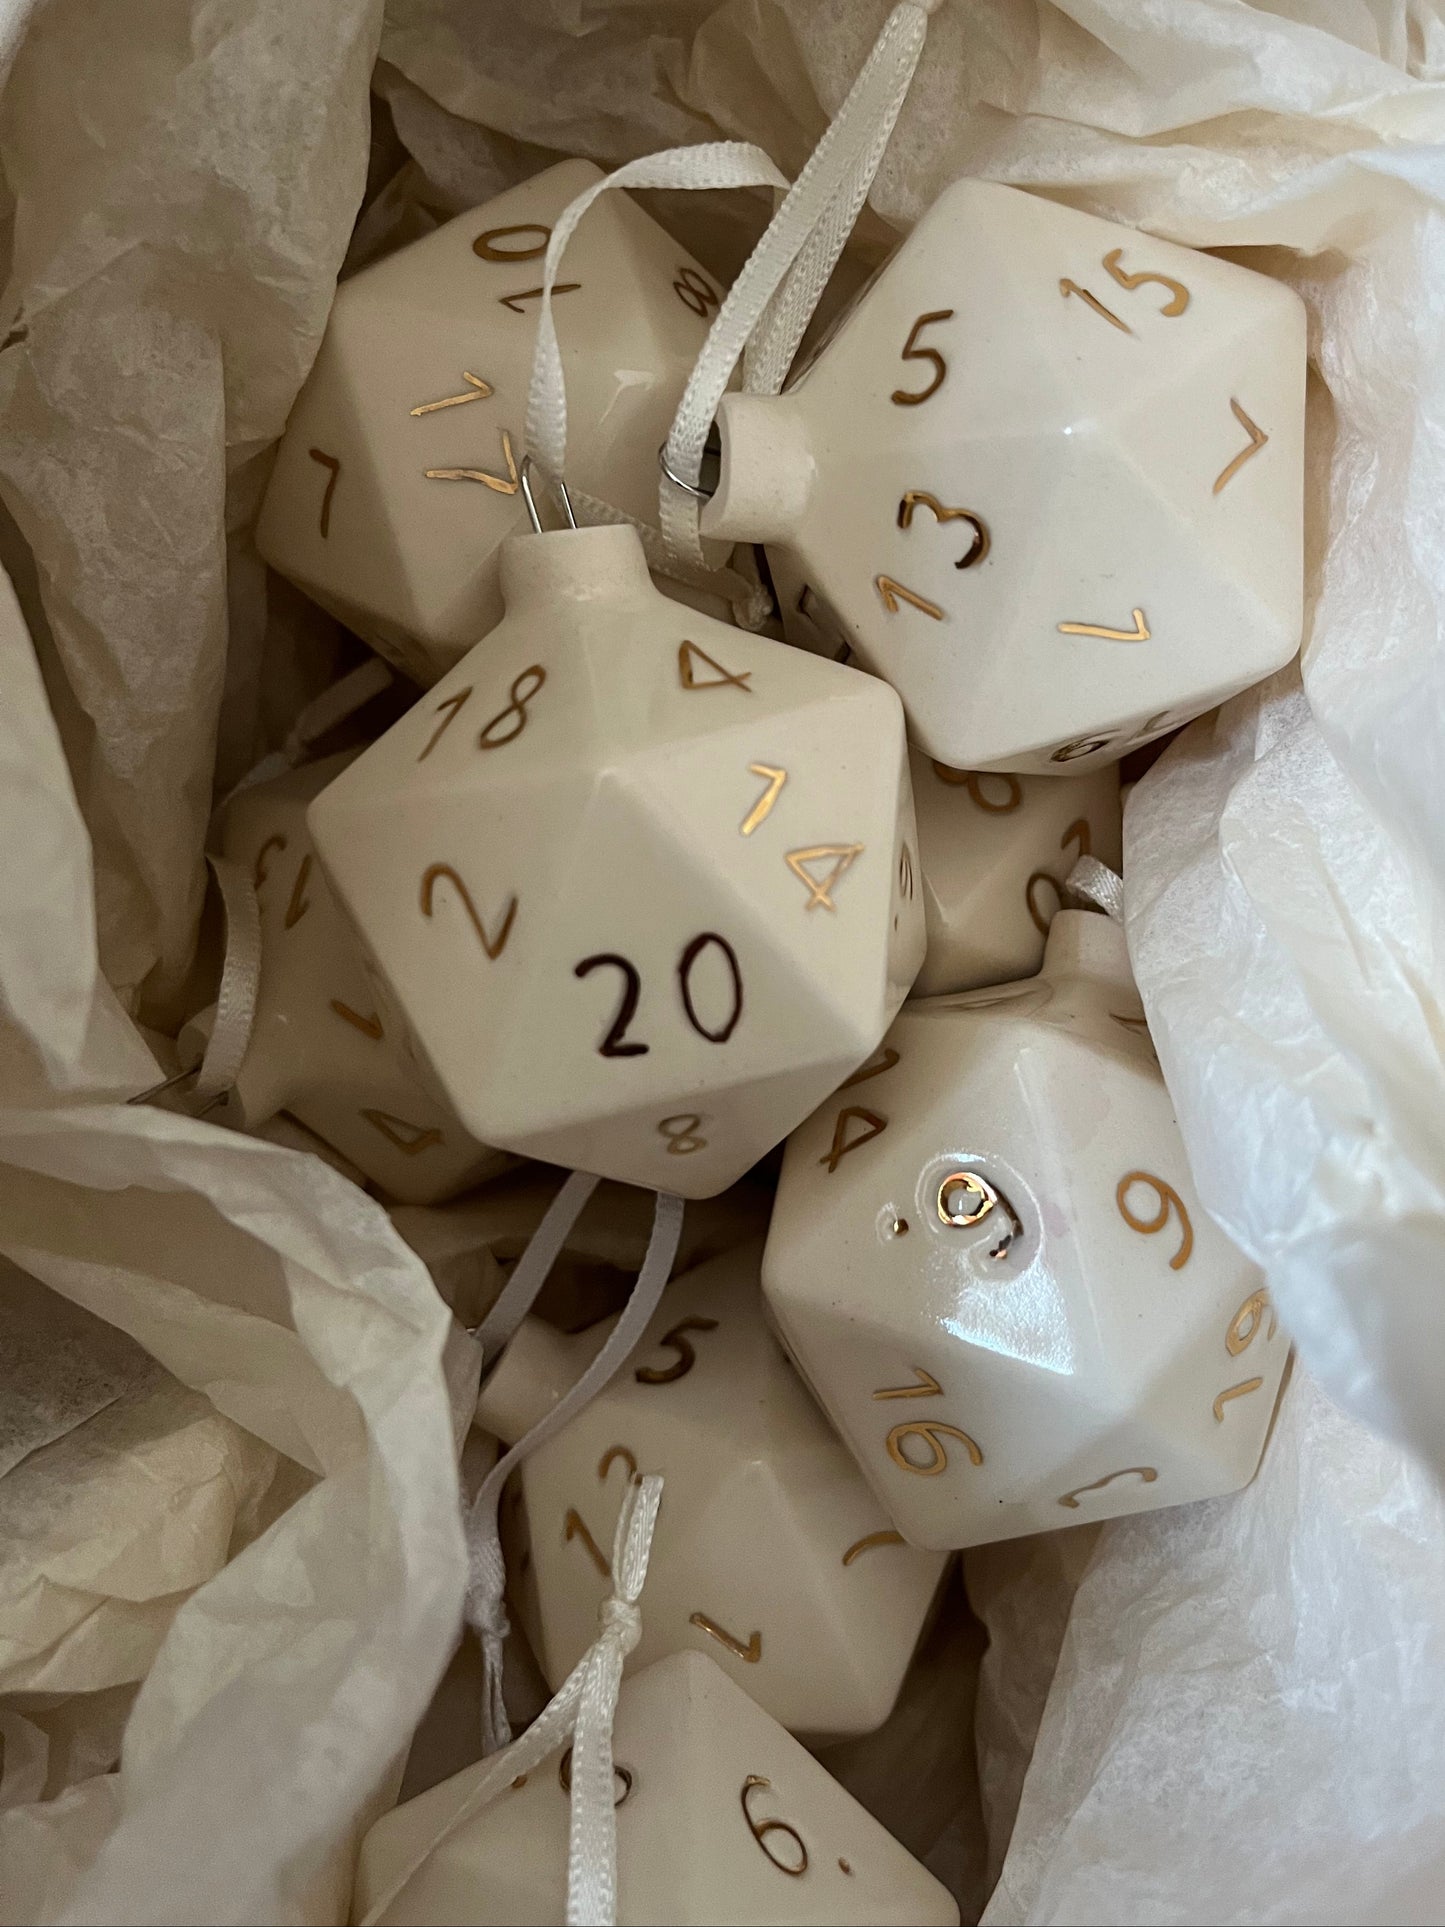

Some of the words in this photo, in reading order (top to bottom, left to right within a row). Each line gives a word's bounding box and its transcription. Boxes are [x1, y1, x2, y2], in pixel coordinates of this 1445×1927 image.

[1059, 248, 1190, 336] 15
[891, 309, 954, 407] 5
[876, 490, 992, 621] 13
[418, 664, 546, 763] 18
[678, 640, 753, 693] 4
[420, 861, 518, 961] 2
[575, 931, 744, 1058] 20
[657, 1113, 707, 1155] 8
[634, 1316, 720, 1385] 5
[872, 1367, 984, 1477] 16
